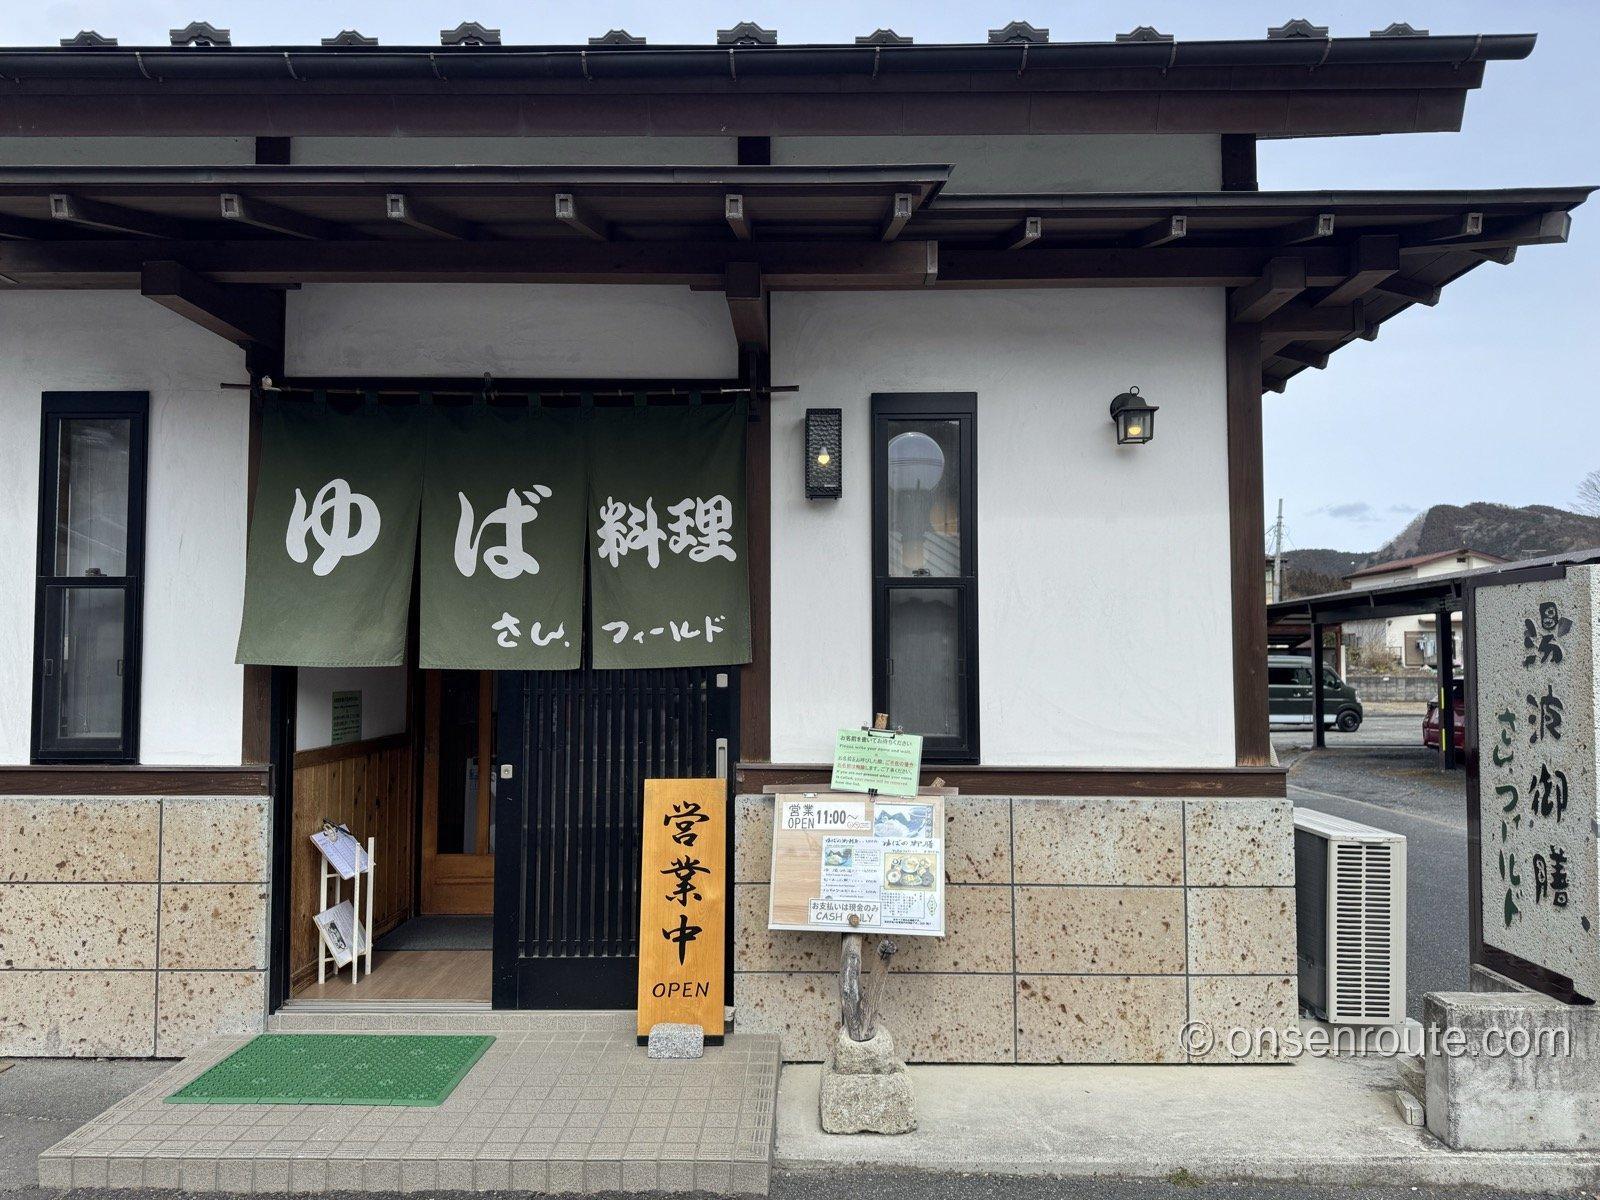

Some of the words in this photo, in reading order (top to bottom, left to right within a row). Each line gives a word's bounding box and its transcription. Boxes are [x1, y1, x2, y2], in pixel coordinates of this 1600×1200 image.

[1522, 602, 1573, 907] 湯波御膳
[789, 803, 814, 817] 営業
[788, 817, 815, 829] OPEN
[660, 801, 711, 966] 営業中
[812, 902, 879, 913] お支払いは現金のみ
[816, 912, 843, 921] CASH
[652, 982, 710, 998] OPEN
